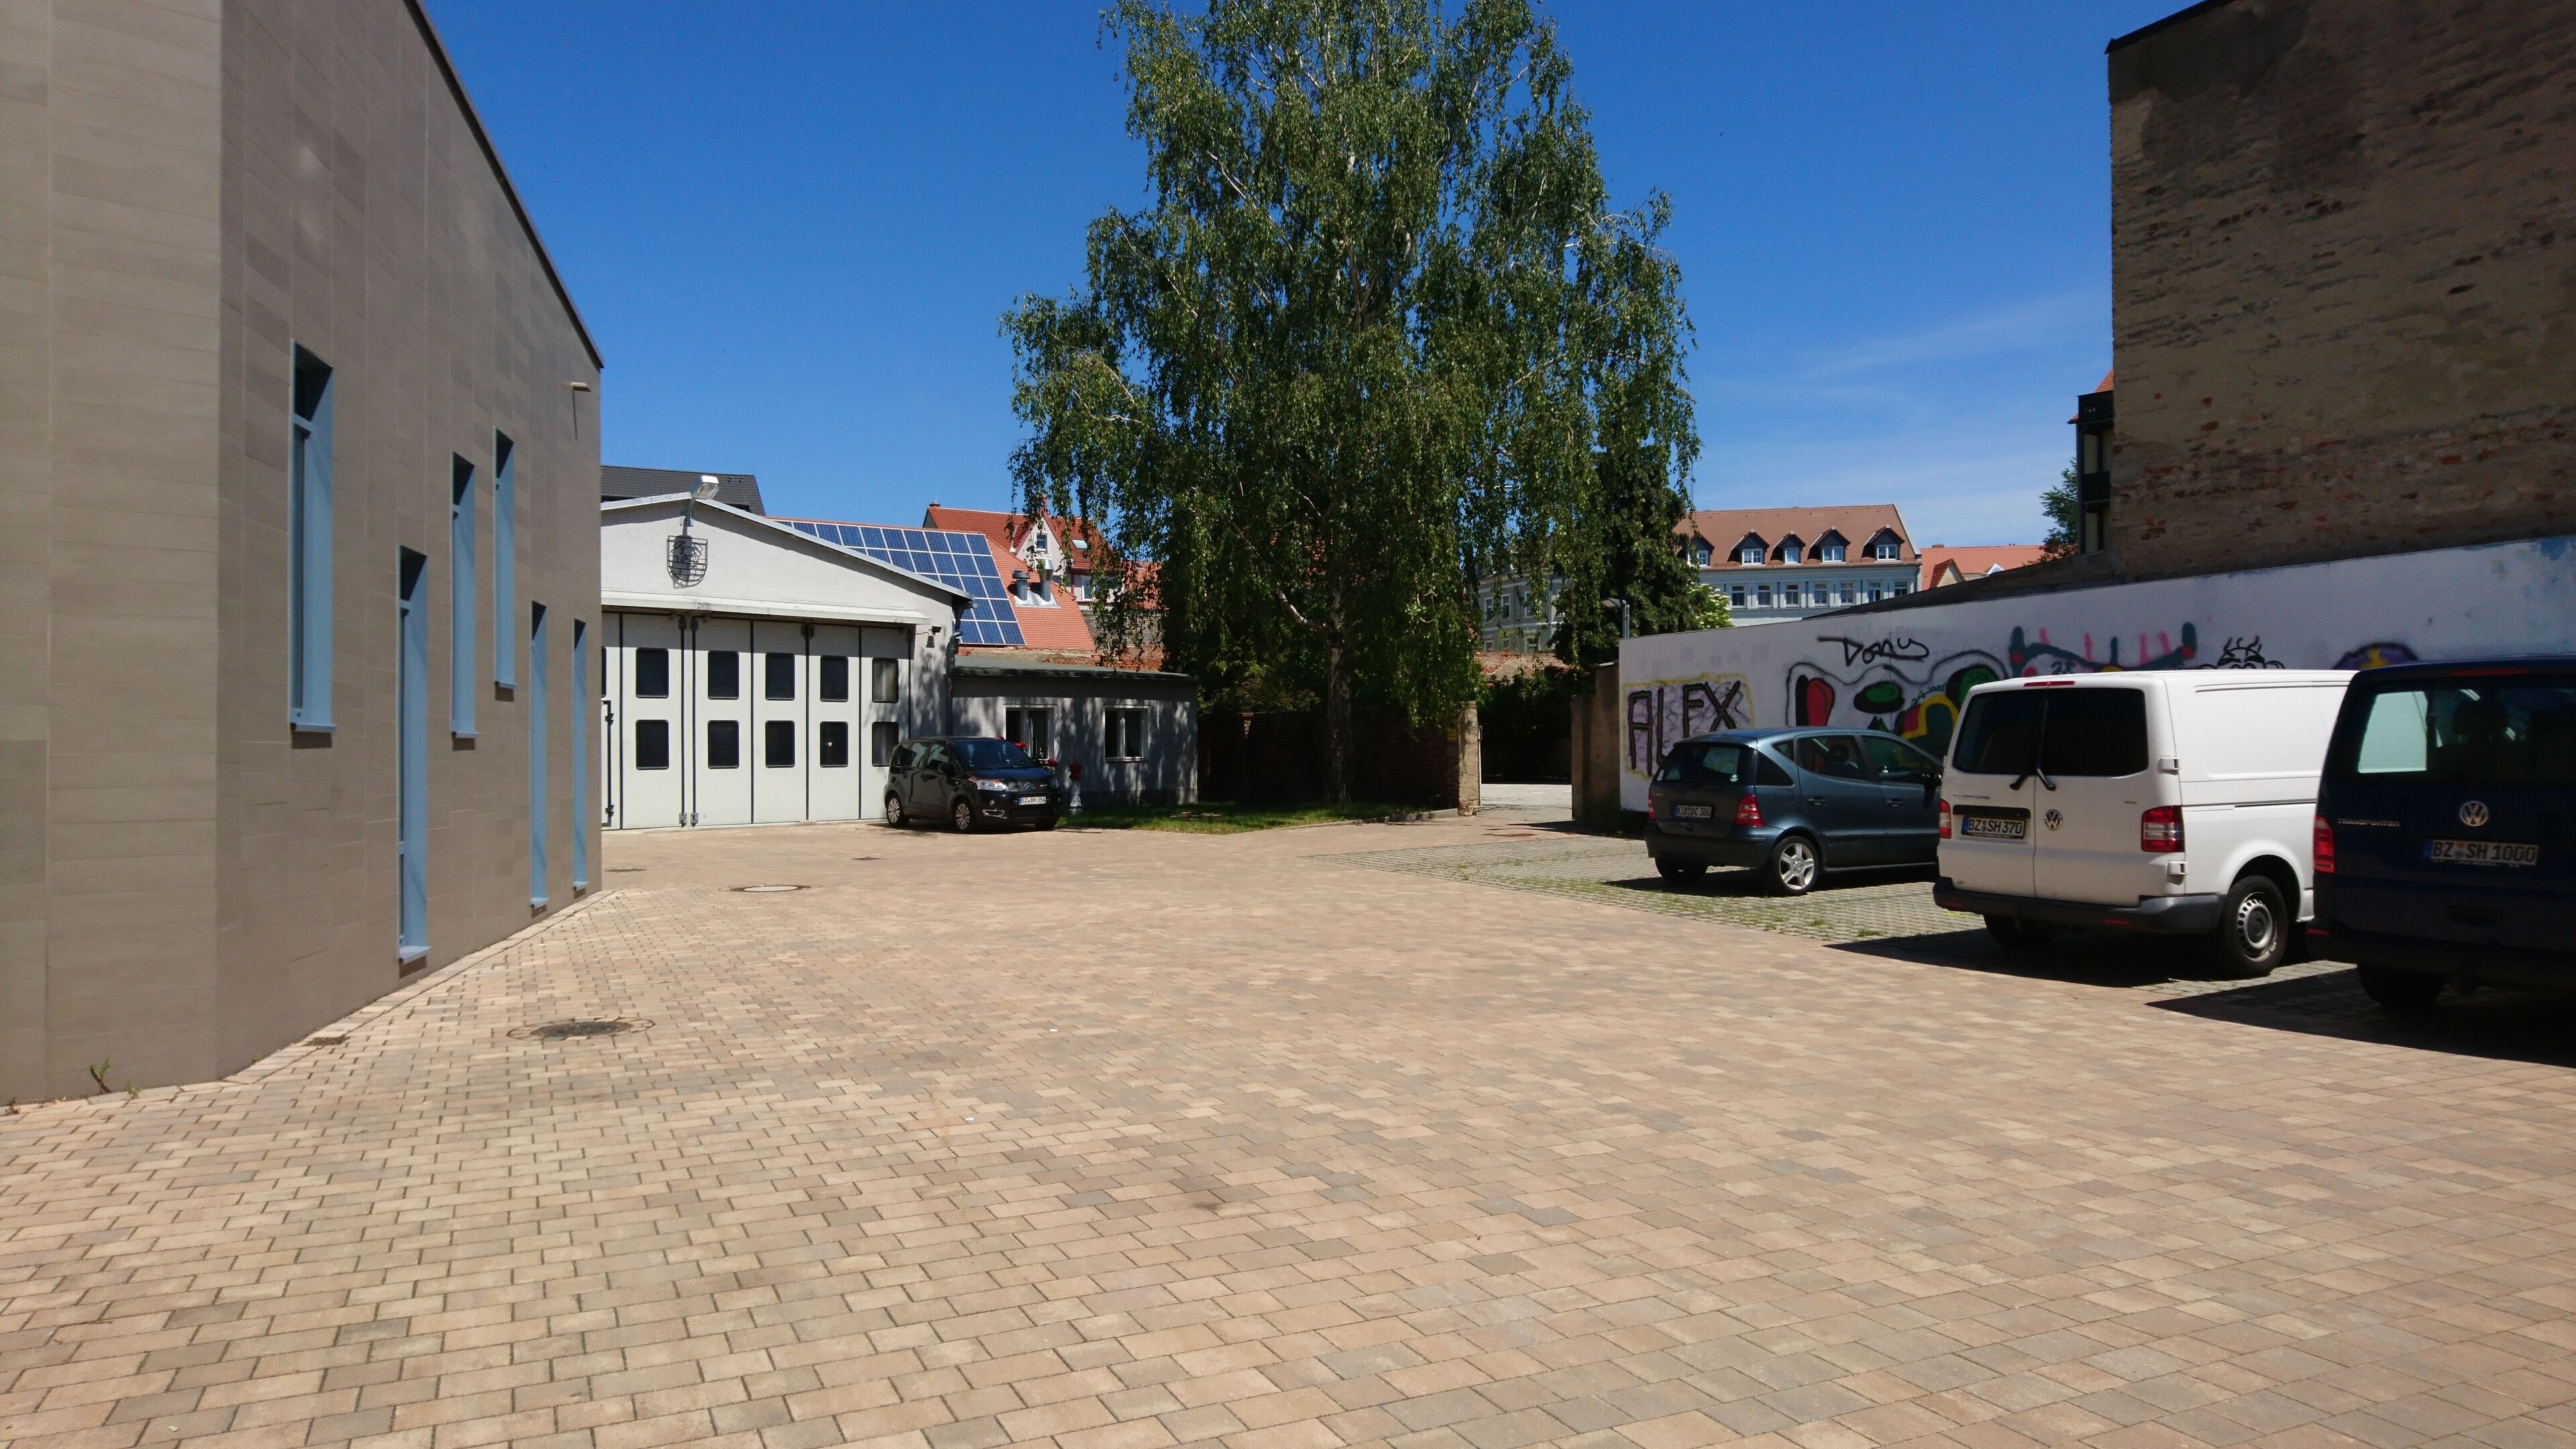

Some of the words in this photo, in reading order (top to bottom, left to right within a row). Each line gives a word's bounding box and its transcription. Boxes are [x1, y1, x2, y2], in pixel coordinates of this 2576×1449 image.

[1677, 806, 1688, 816] KIB
[1690, 807, 1699, 816] BC
[1700, 807, 1711, 817] 300
[1968, 819, 1981, 831] BZ
[1987, 820, 2001, 833] SH
[2002, 822, 2023, 834] 370
[2433, 842, 2455, 857] BZ
[2466, 844, 2488, 859] SH
[2491, 845, 2536, 863] 1000
